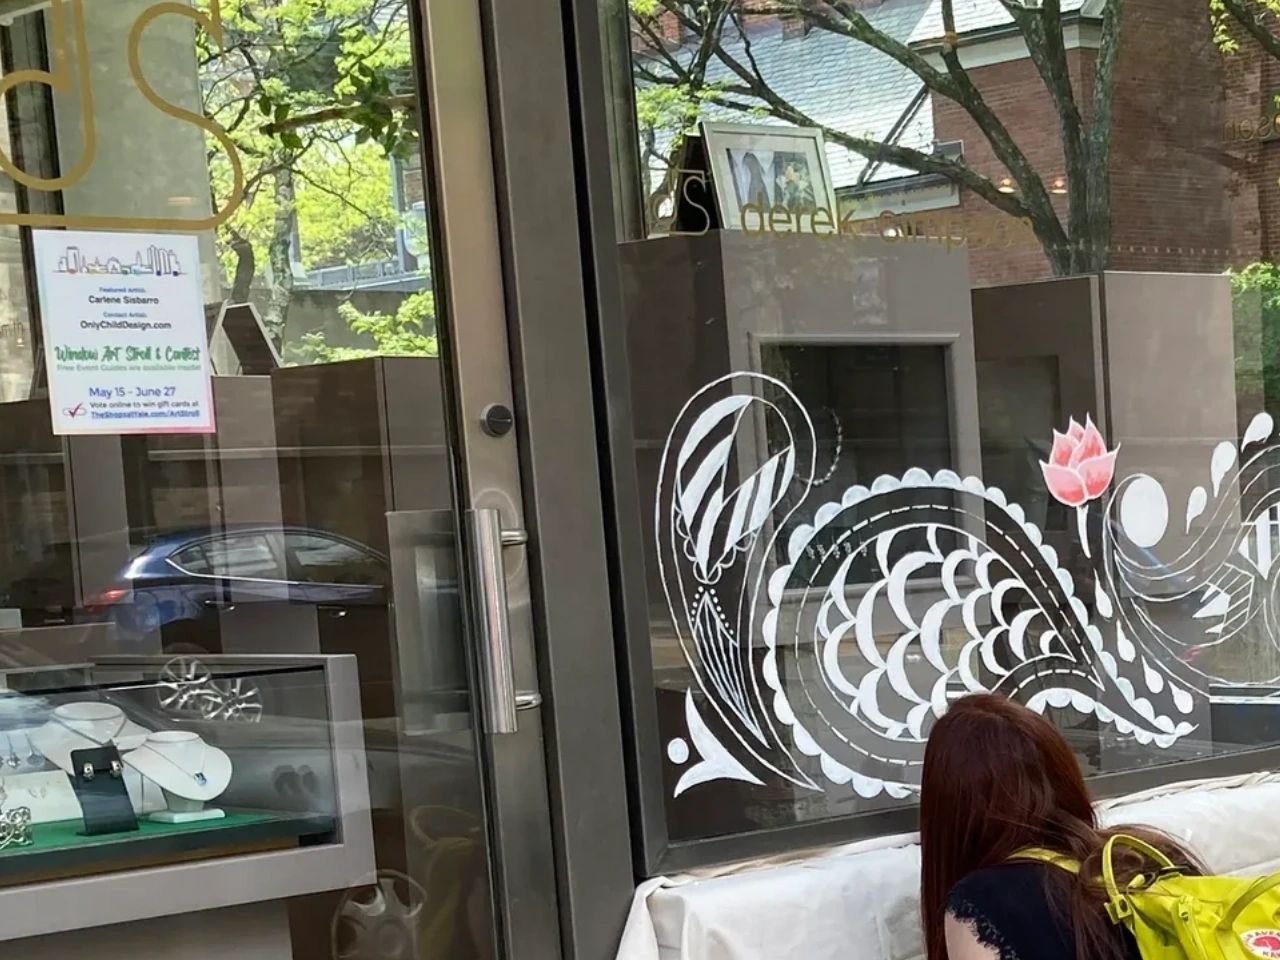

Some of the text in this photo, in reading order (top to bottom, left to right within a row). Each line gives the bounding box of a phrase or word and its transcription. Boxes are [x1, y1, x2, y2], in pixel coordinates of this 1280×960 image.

[740, 192, 856, 240] derek
[88, 295, 160, 305] Carlene Sisbarro
[80, 320, 172, 331] OnlyChildDesign.com
[89, 387, 112, 400] May
[115, 388, 126, 398] 15
[135, 387, 161, 398] June
[163, 387, 176, 397] 27
